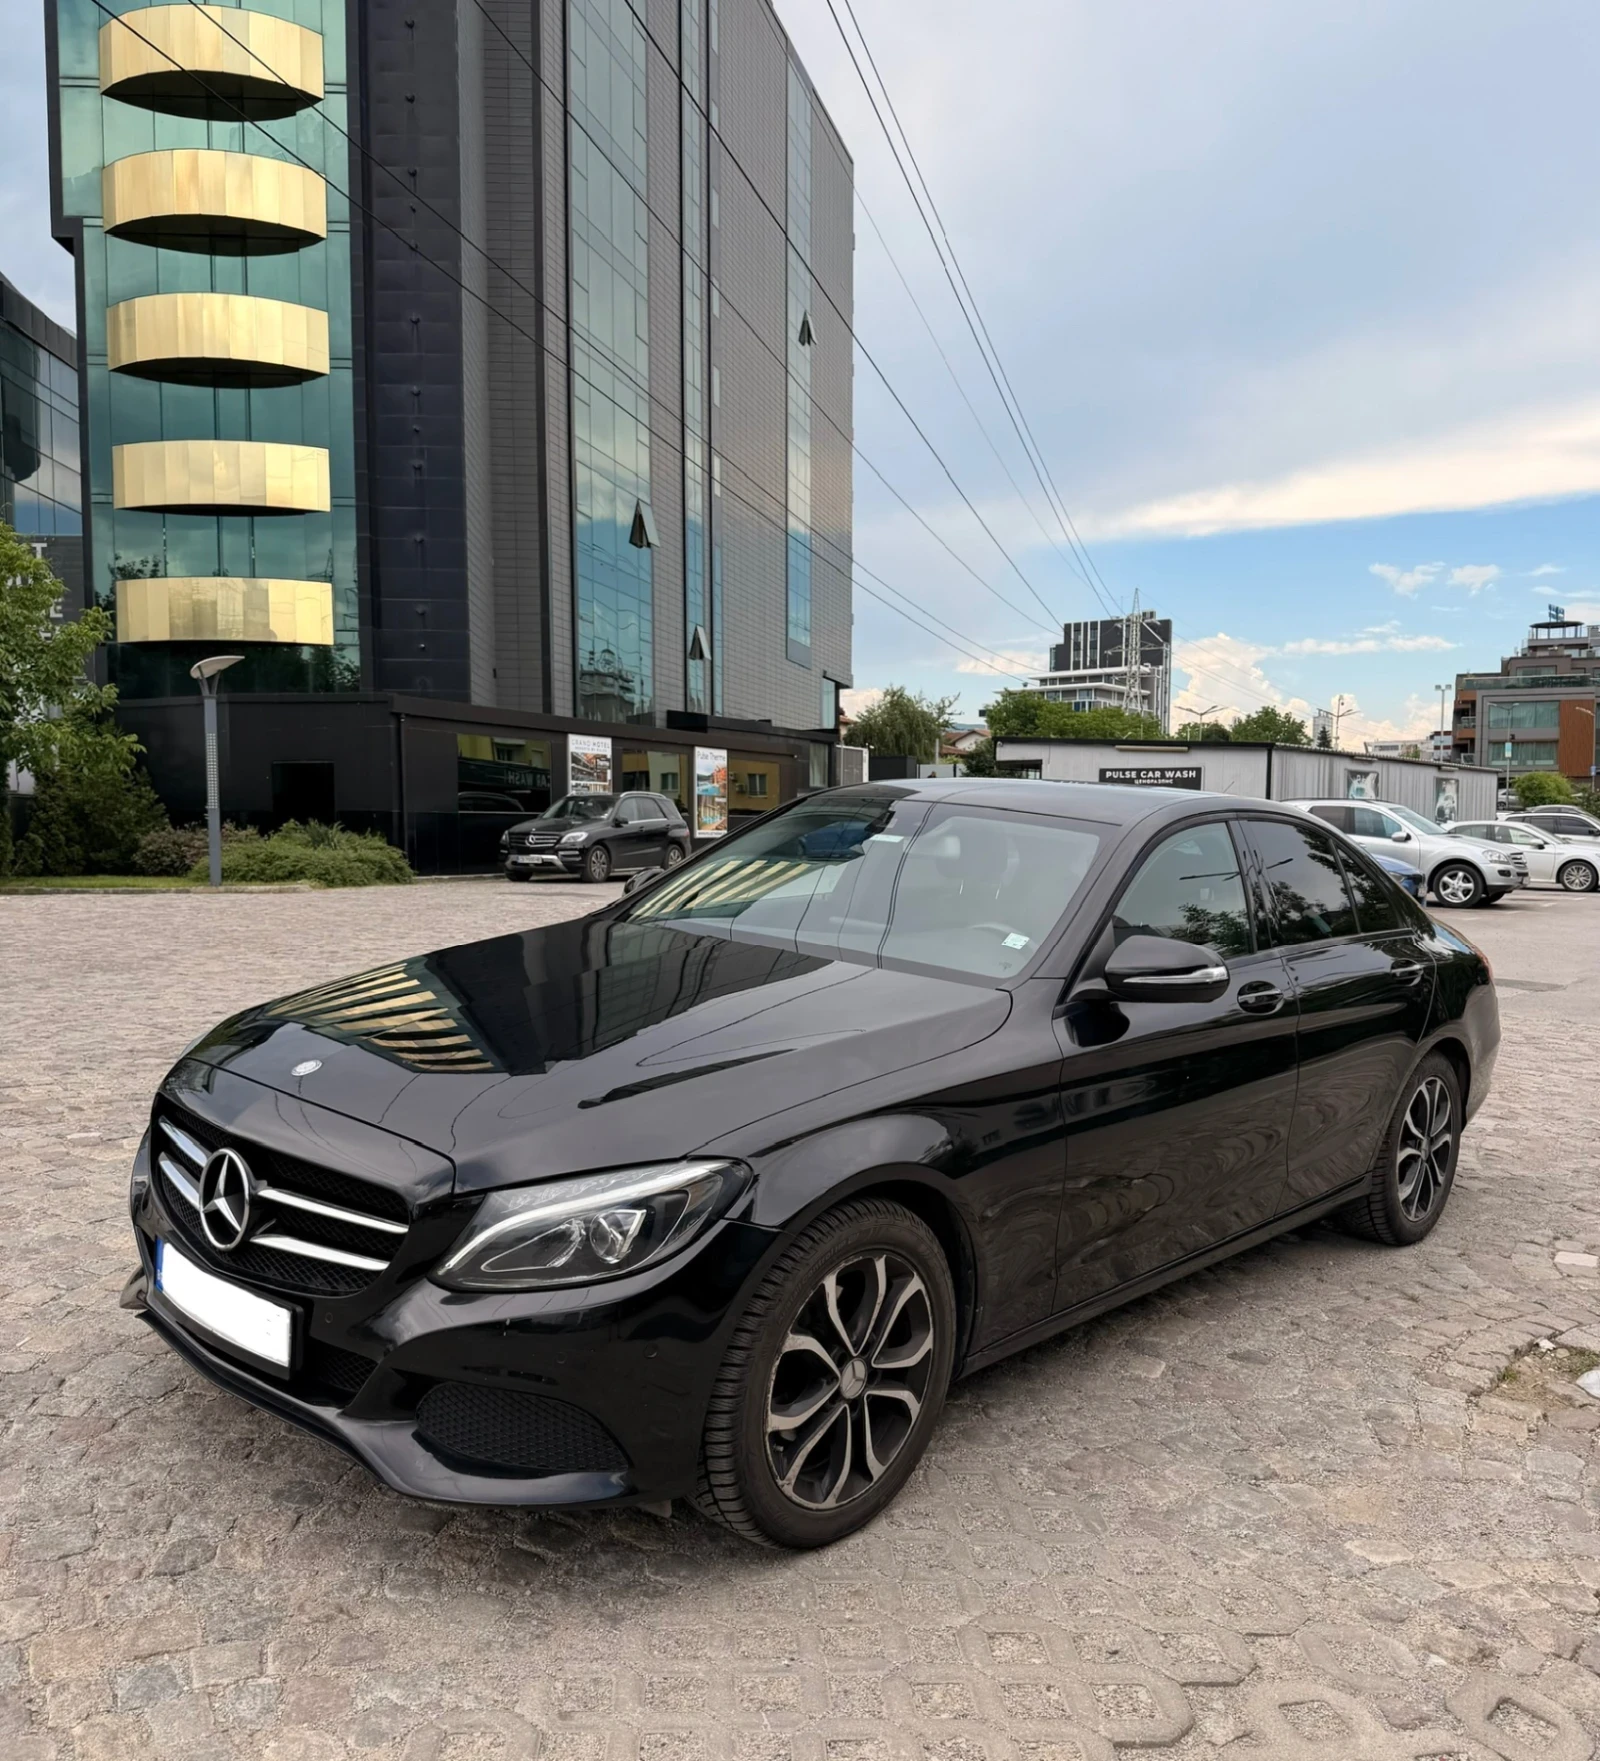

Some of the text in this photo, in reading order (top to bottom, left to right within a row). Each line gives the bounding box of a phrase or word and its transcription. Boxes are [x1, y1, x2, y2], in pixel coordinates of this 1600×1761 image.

[592, 741, 610, 749] HOTEL
[1140, 770, 1161, 778] CAR
[1164, 770, 1196, 778] WASH
